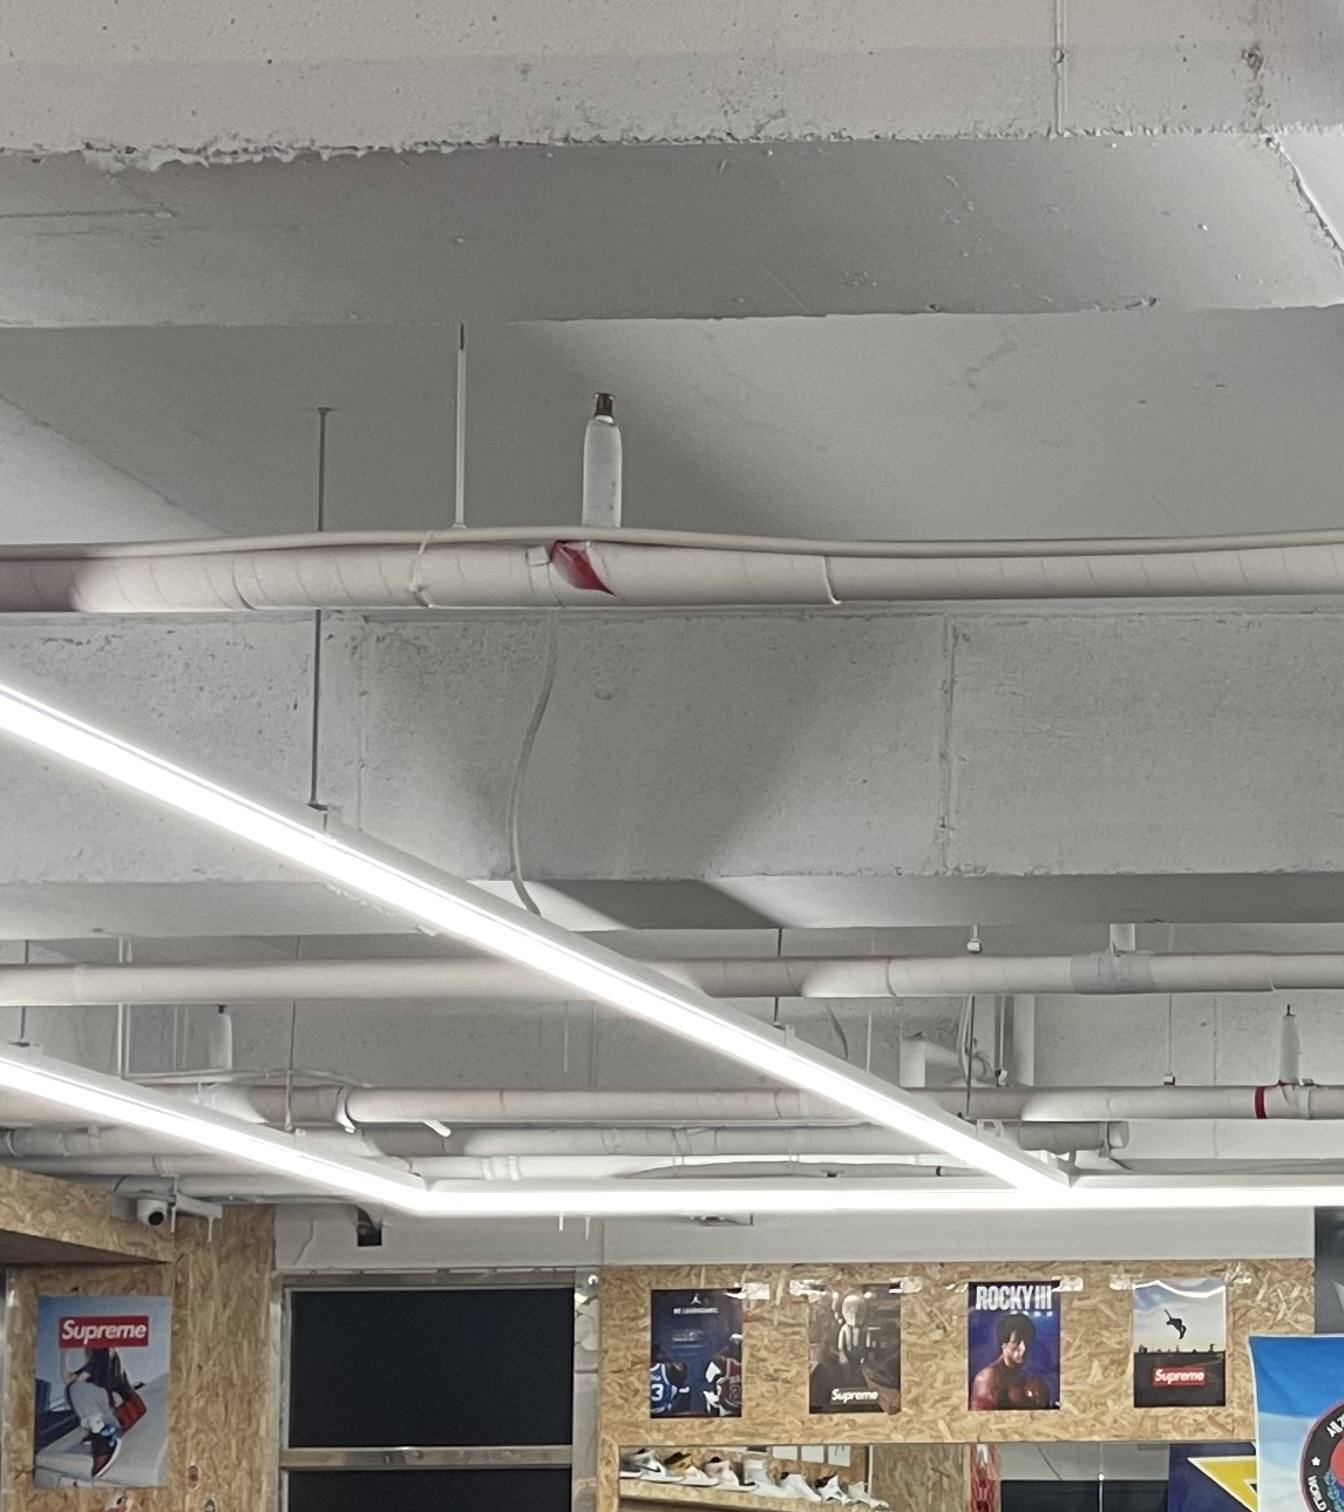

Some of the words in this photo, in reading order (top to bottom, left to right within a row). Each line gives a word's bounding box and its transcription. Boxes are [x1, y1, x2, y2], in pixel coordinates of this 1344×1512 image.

[975, 1285, 1034, 1311] ROCKY
[1034, 1284, 1052, 1309] III
[61, 1319, 147, 1345] Supreme
[1154, 1368, 1206, 1384] Supreme
[831, 1388, 879, 1403] Supreme
[1307, 1474, 1327, 1512] WORLD
